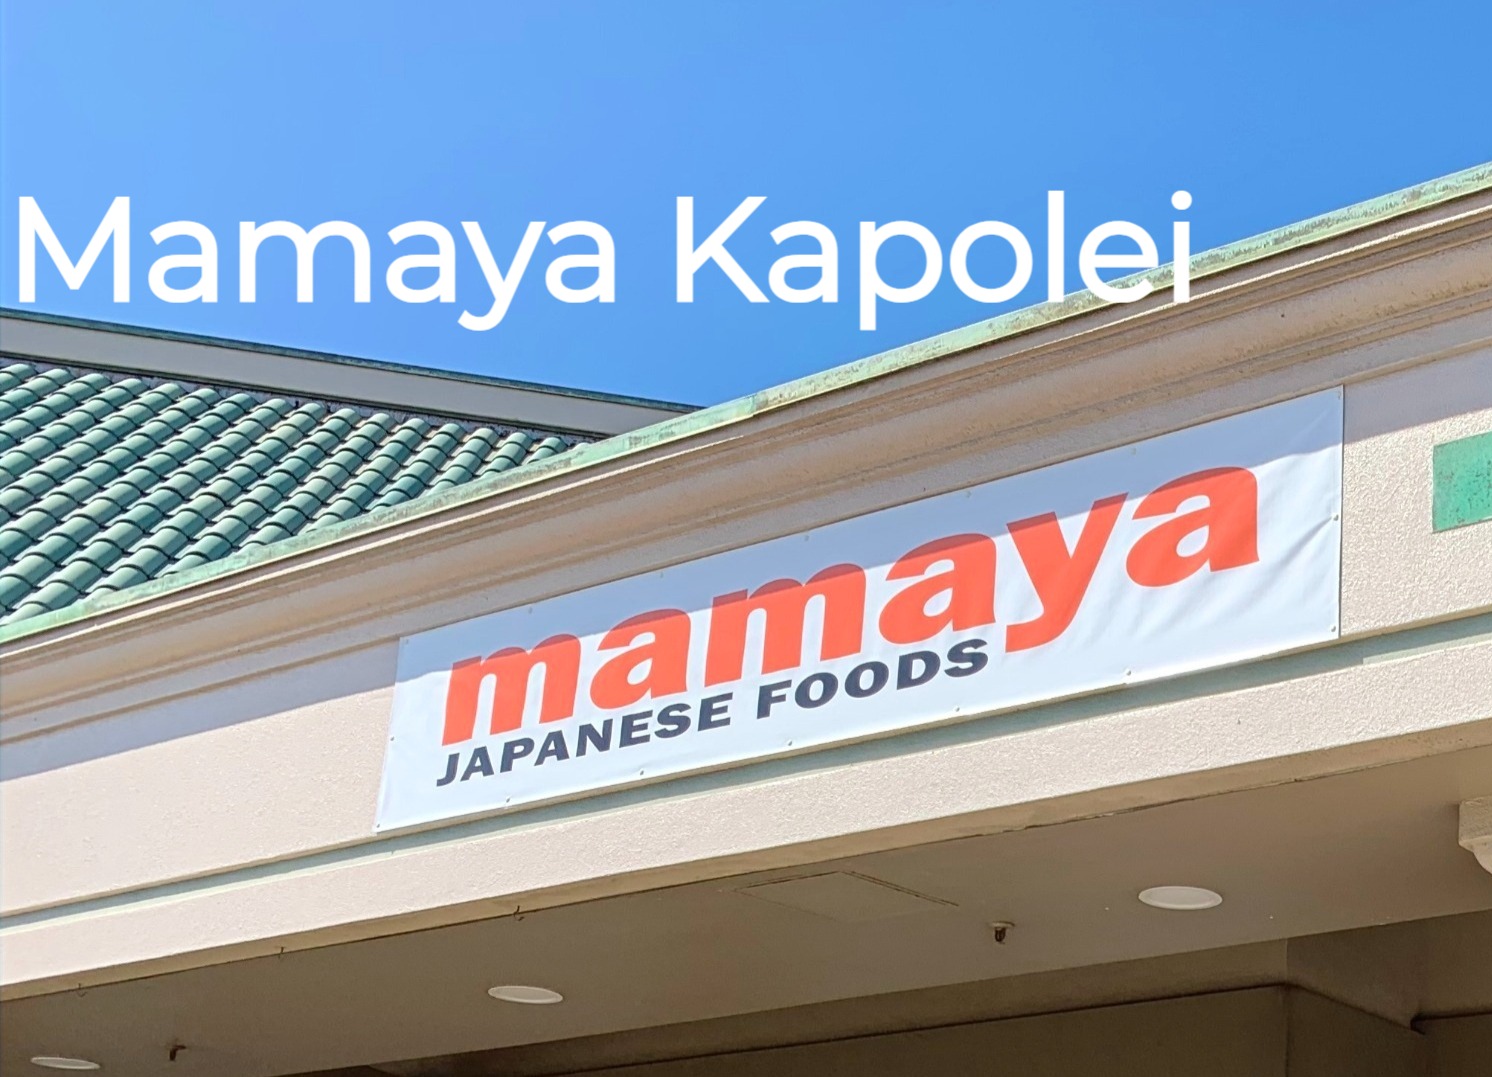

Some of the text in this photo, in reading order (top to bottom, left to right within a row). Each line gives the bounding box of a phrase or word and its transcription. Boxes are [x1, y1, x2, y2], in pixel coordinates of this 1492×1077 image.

[436, 638, 989, 787] JAPANESE FOODS
[441, 466, 1261, 747] mamaya
